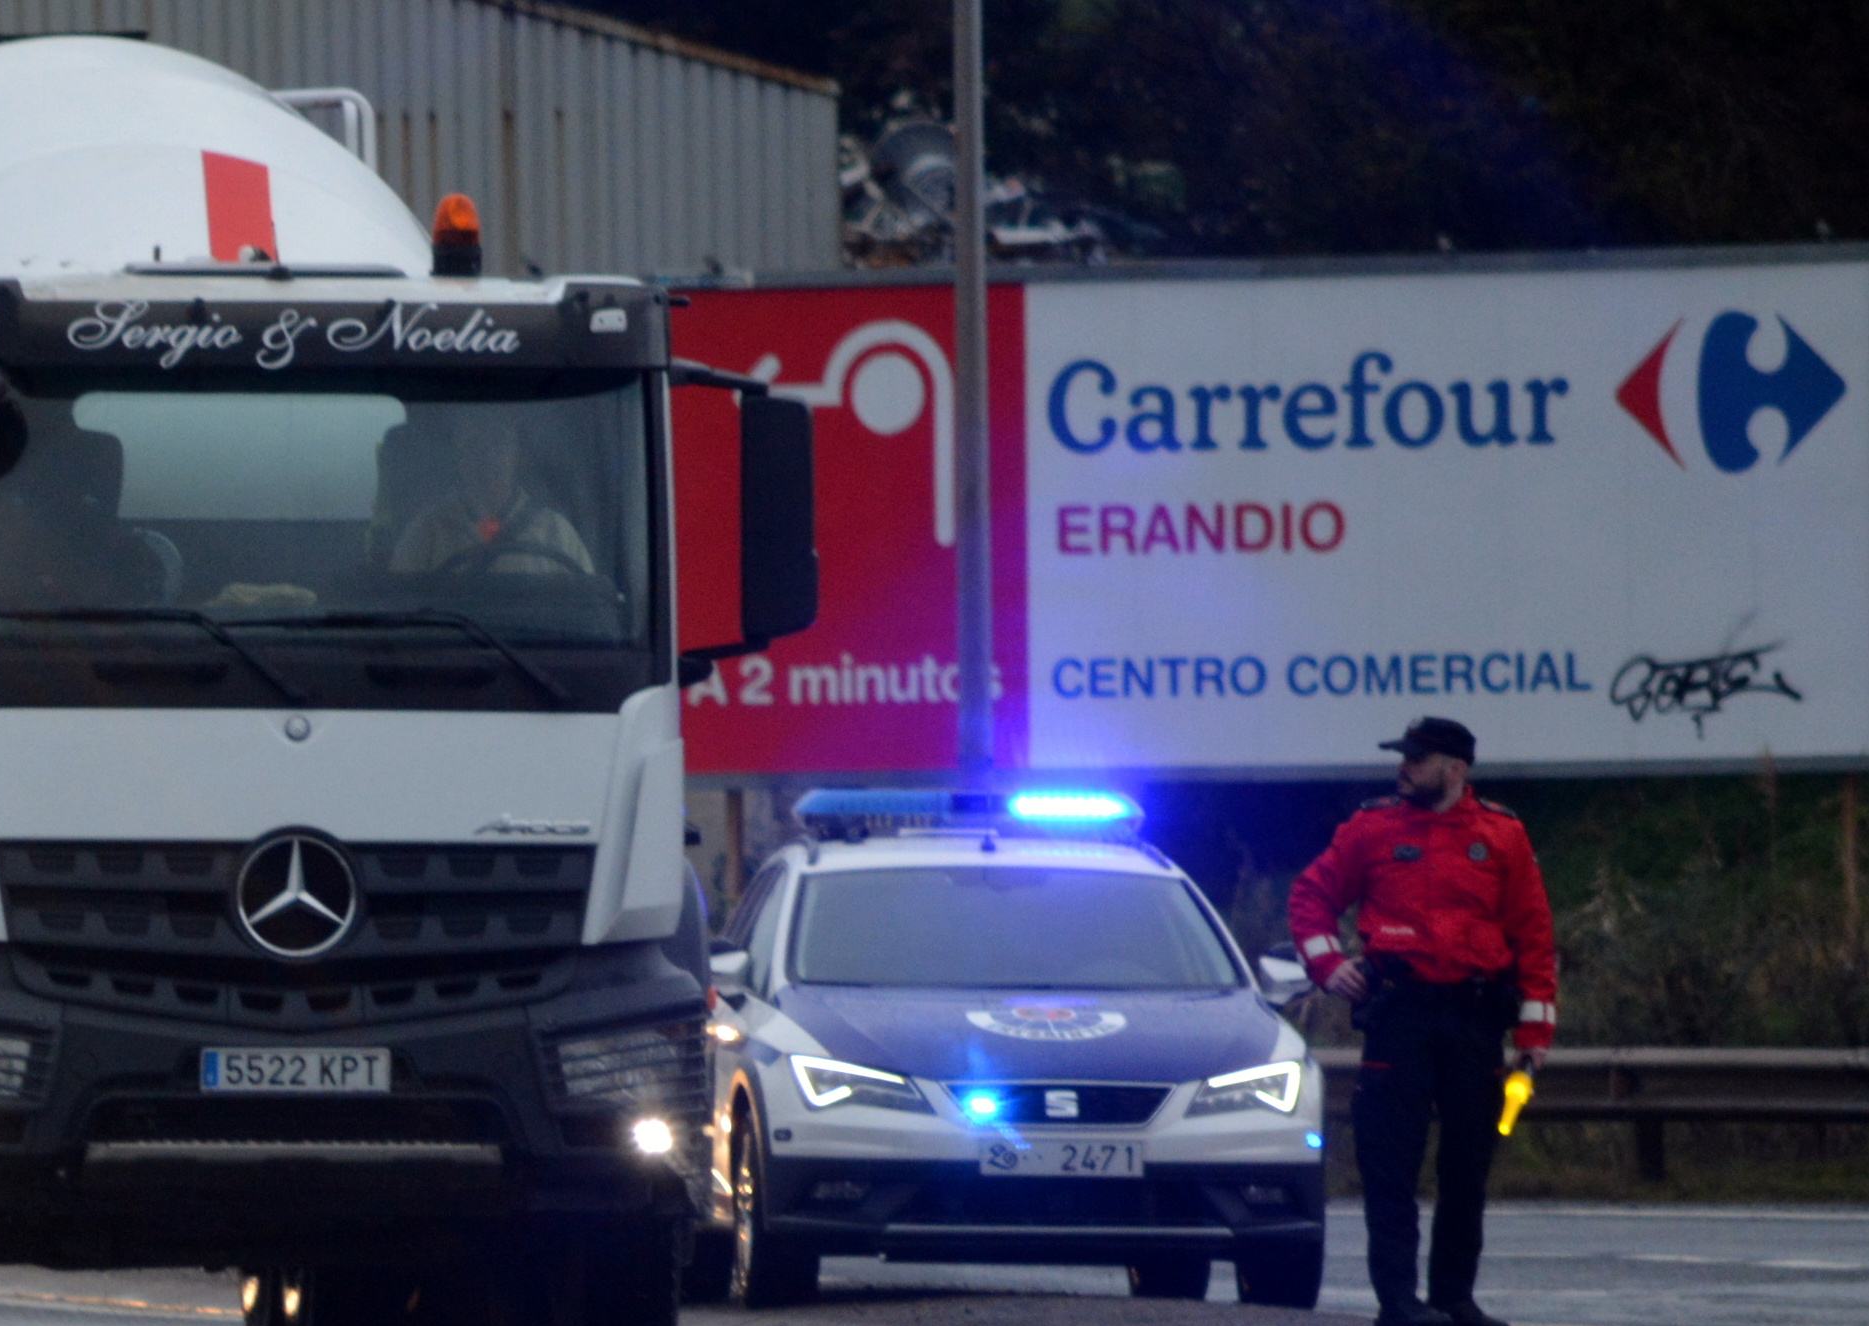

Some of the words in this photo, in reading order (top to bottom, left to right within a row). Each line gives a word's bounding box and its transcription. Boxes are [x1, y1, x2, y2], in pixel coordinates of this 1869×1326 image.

[67, 299, 243, 370] Sergio
[256, 308, 318, 370] &
[326, 299, 522, 354] Noelia
[1046, 350, 1570, 455] Carrefour
[1056, 502, 1345, 556] ERANDIO
[739, 654, 775, 706] 2
[1051, 655, 1268, 699] CENTRO
[1285, 652, 1592, 697] COMERCIAL
[225, 1055, 307, 1085] 5522
[319, 1055, 380, 1086] KPT
[1061, 1144, 1134, 1172] 2471
